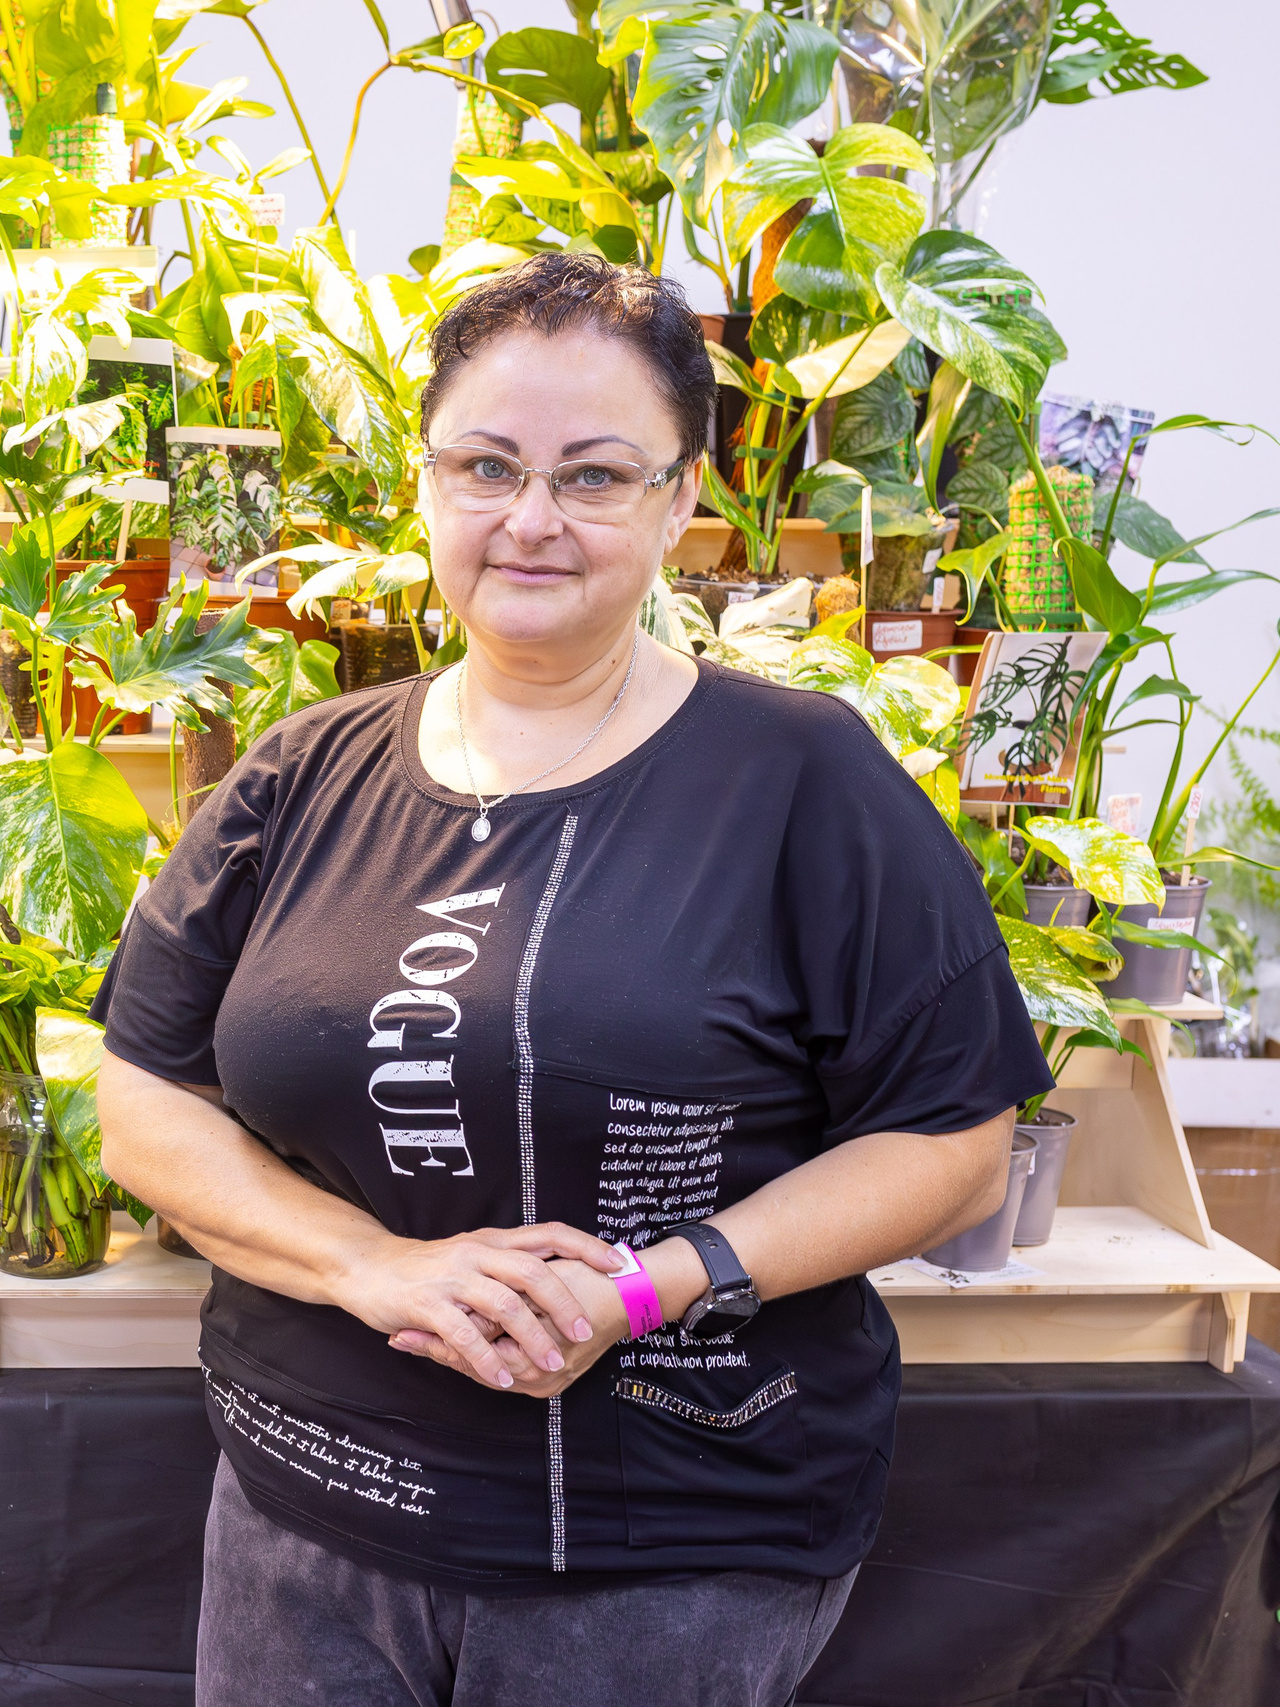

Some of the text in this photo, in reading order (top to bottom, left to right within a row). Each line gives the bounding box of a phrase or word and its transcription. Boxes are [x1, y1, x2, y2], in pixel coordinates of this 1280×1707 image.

[1040, 784, 1068, 795] Flame
[367, 882, 506, 1177] VOGUE
[610, 1092, 646, 1113] Lorem
[650, 1101, 680, 1118] ipsum
[682, 1103, 705, 1117] dolor
[607, 1121, 673, 1138] consectetur
[603, 1141, 627, 1155] sed
[629, 1142, 643, 1155] do
[645, 1140, 684, 1155] eiusmod
[684, 1135, 710, 1154] tempor
[600, 1152, 723, 1173] cididunt ut labore et dolore
[599, 1177, 634, 1196] magna
[667, 1175, 681, 1189] Ut
[681, 1175, 702, 1188] enim
[704, 1169, 718, 1183] ad
[597, 1196, 628, 1211] minim
[661, 1193, 682, 1211] quis
[683, 1185, 719, 1204] nostrud
[648, 1210, 682, 1223] ullamco
[683, 1204, 715, 1220] laboris
[597, 1229, 616, 1241] nisi
[619, 1351, 636, 1369] cat
[682, 1356, 704, 1370] non
[705, 1350, 751, 1372] proident.
[343, 1458, 360, 1472] et
[359, 1460, 395, 1484] dolore
[398, 1479, 437, 1501] magna
[354, 1487, 398, 1508] nostrud
